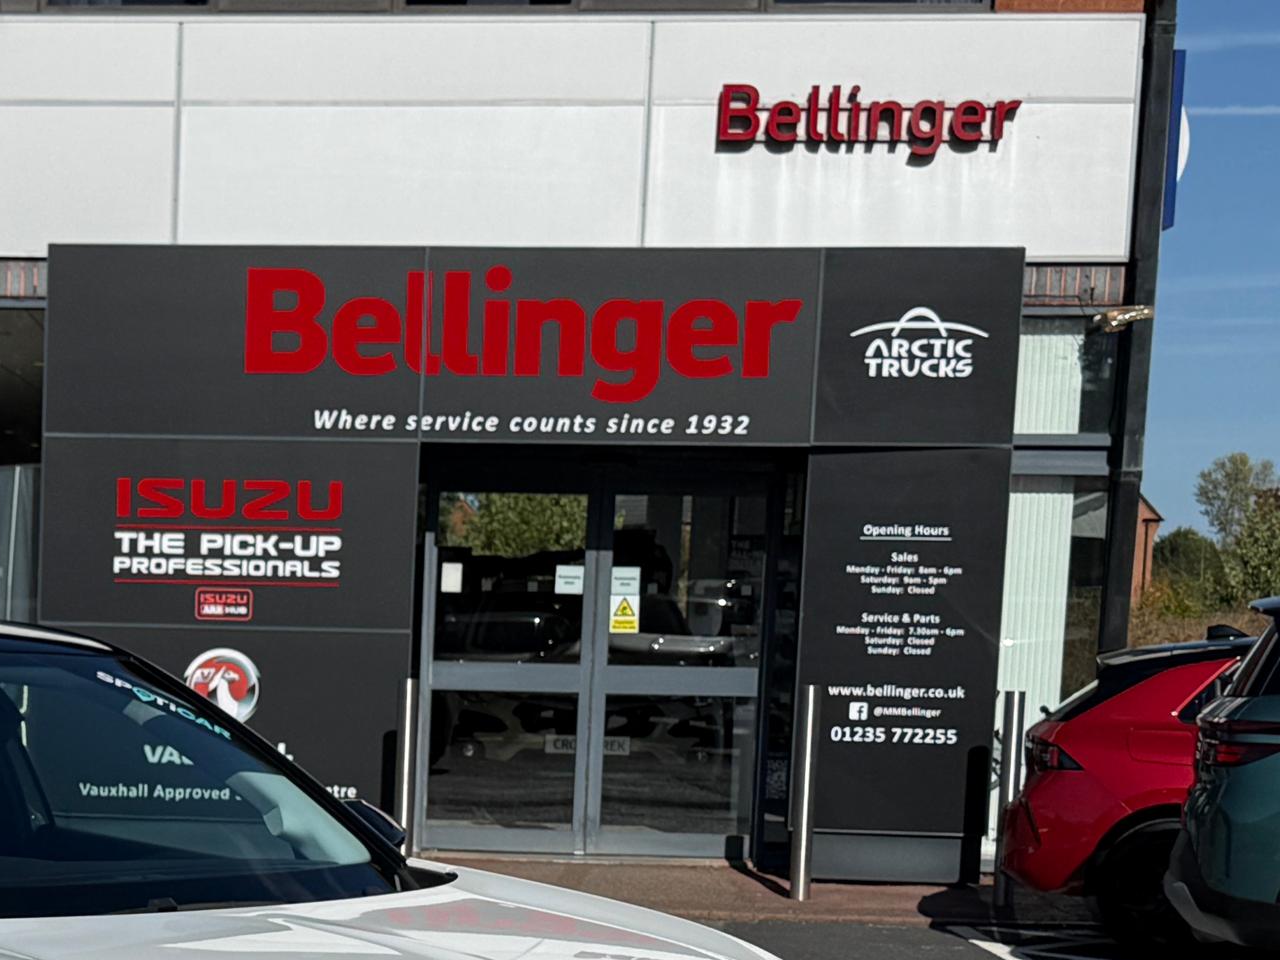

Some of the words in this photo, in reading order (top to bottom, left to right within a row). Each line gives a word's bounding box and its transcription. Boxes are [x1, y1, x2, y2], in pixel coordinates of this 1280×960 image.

[719, 84, 1022, 156] Bellinger
[244, 265, 804, 403] Bellinger
[865, 338, 973, 358] ARCTIC
[864, 358, 973, 378] TRUCKS
[313, 408, 396, 431] Where
[405, 410, 499, 433] service
[508, 412, 596, 433] counts
[606, 412, 675, 434] since
[685, 414, 750, 435] 1932
[116, 477, 343, 521] ISUZU
[863, 524, 912, 537] Opening
[914, 525, 950, 536] Hours
[114, 532, 185, 555] THE
[200, 533, 342, 557] PICK-UP
[890, 552, 919, 562] Sales
[113, 556, 341, 578] PROFESSIONALS
[846, 565, 880, 575] Monday
[886, 565, 915, 575] Friday:
[943, 566, 962, 576] 6pm
[860, 575, 899, 585] Saturday:
[871, 585, 904, 595] Sunday:
[907, 586, 935, 595] Closed
[200, 593, 247, 604] ISUZU
[861, 612, 900, 623] Service
[901, 613, 911, 624] &
[913, 613, 940, 624] Parts
[836, 626, 870, 635] Monday
[945, 627, 965, 637] 6pm
[907, 636, 935, 646] Closed
[903, 646, 931, 655] Closed
[828, 684, 966, 700] www.bellinger.co.uk
[830, 726, 886, 743] 01235
[891, 727, 958, 744] 772255
[79, 782, 148, 798] Vauxhall
[153, 784, 230, 801] Approved
